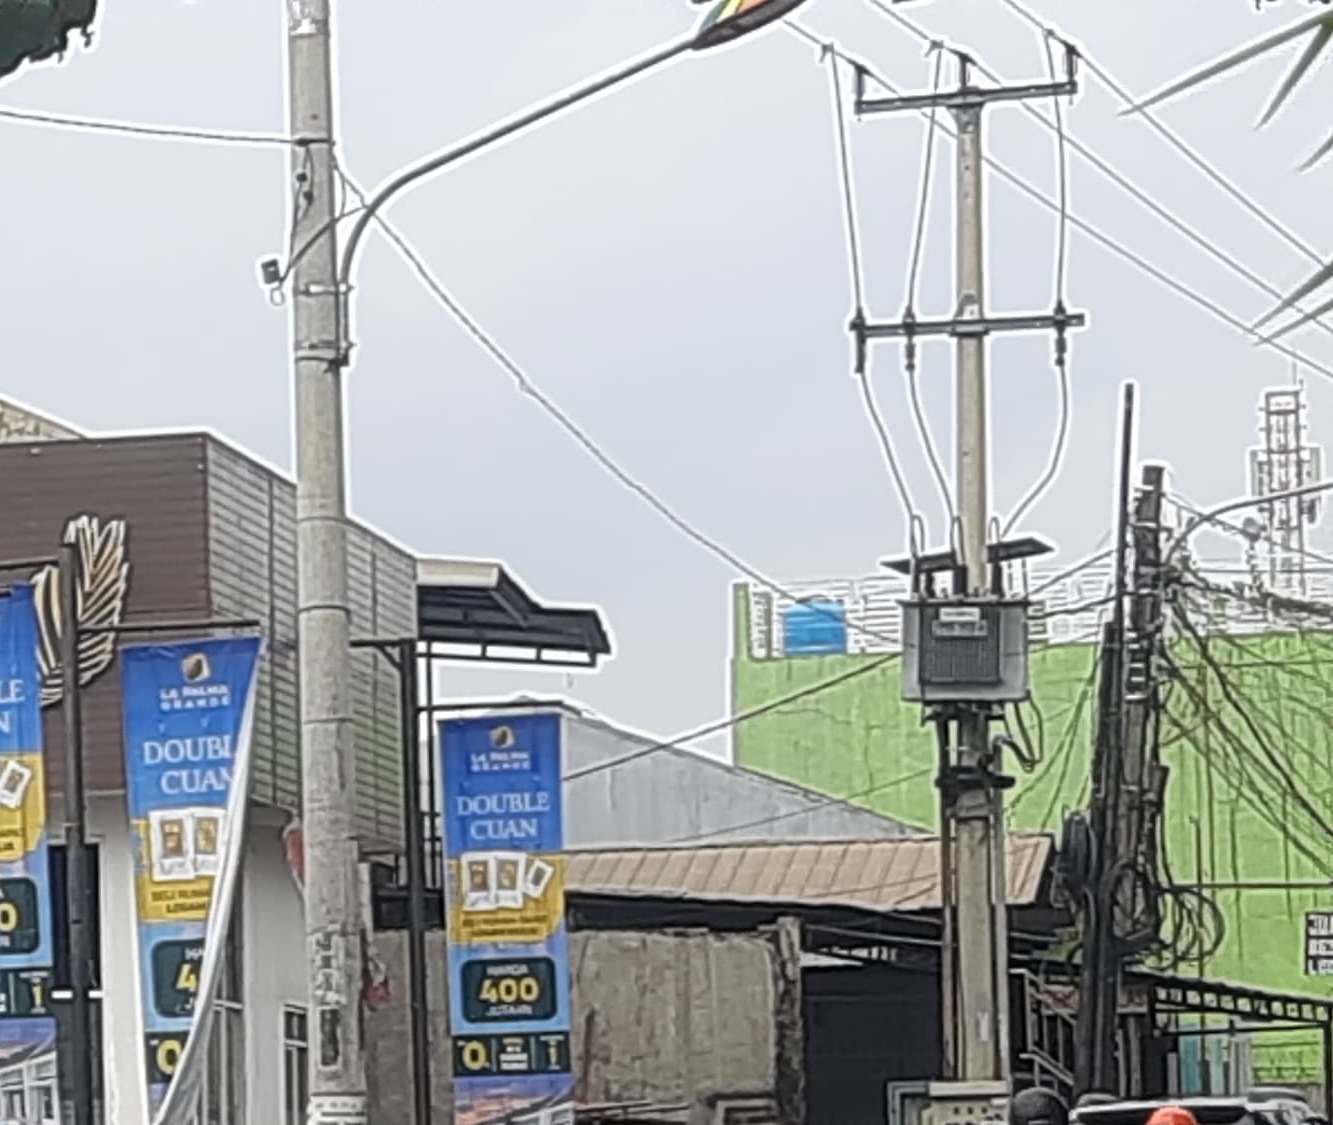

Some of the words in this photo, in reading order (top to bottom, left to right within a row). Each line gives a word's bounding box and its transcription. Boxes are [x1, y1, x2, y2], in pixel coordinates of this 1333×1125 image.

[456, 791, 550, 815] DOUBLE
[469, 818, 538, 840] CUAN
[478, 976, 539, 1004] 400
